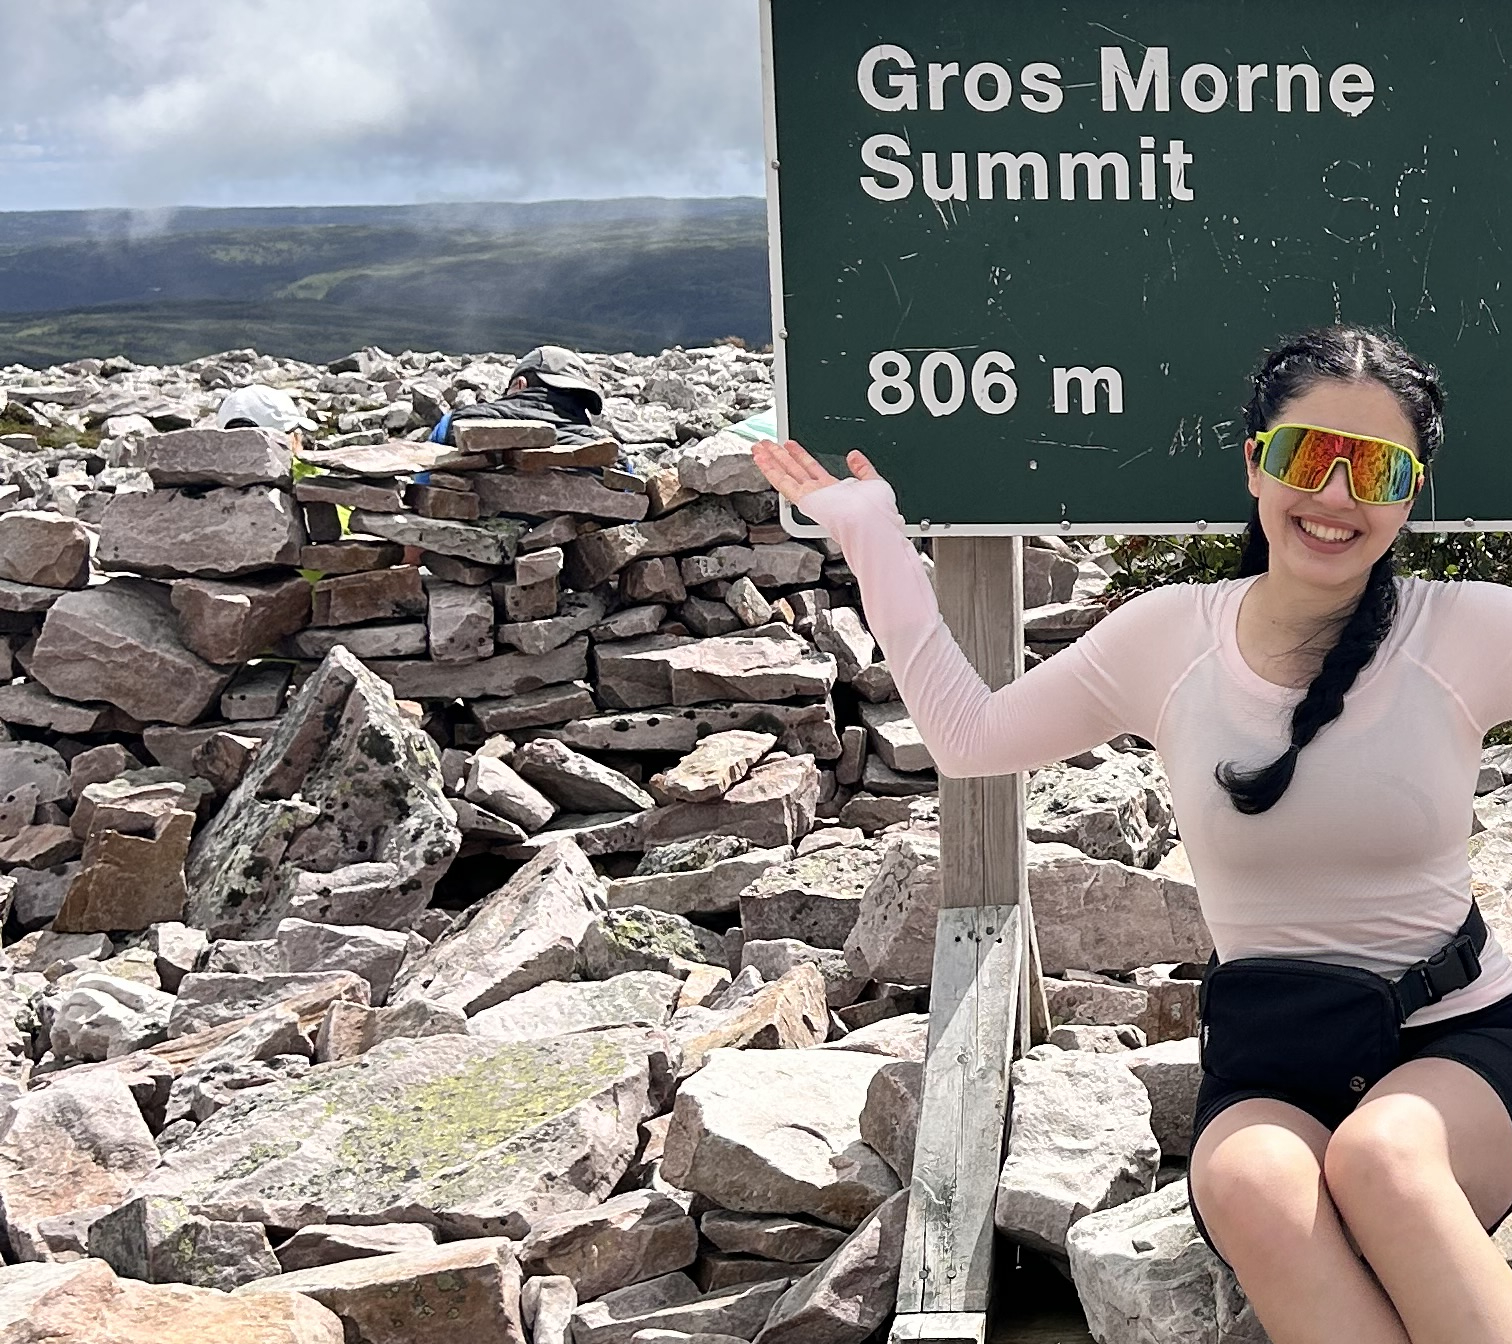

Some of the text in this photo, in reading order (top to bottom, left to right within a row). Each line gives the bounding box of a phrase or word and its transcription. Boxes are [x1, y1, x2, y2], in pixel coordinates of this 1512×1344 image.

[857, 44, 1375, 115] Gros Morne
[859, 133, 1195, 202] Summit
[867, 350, 1125, 416] 806 m
